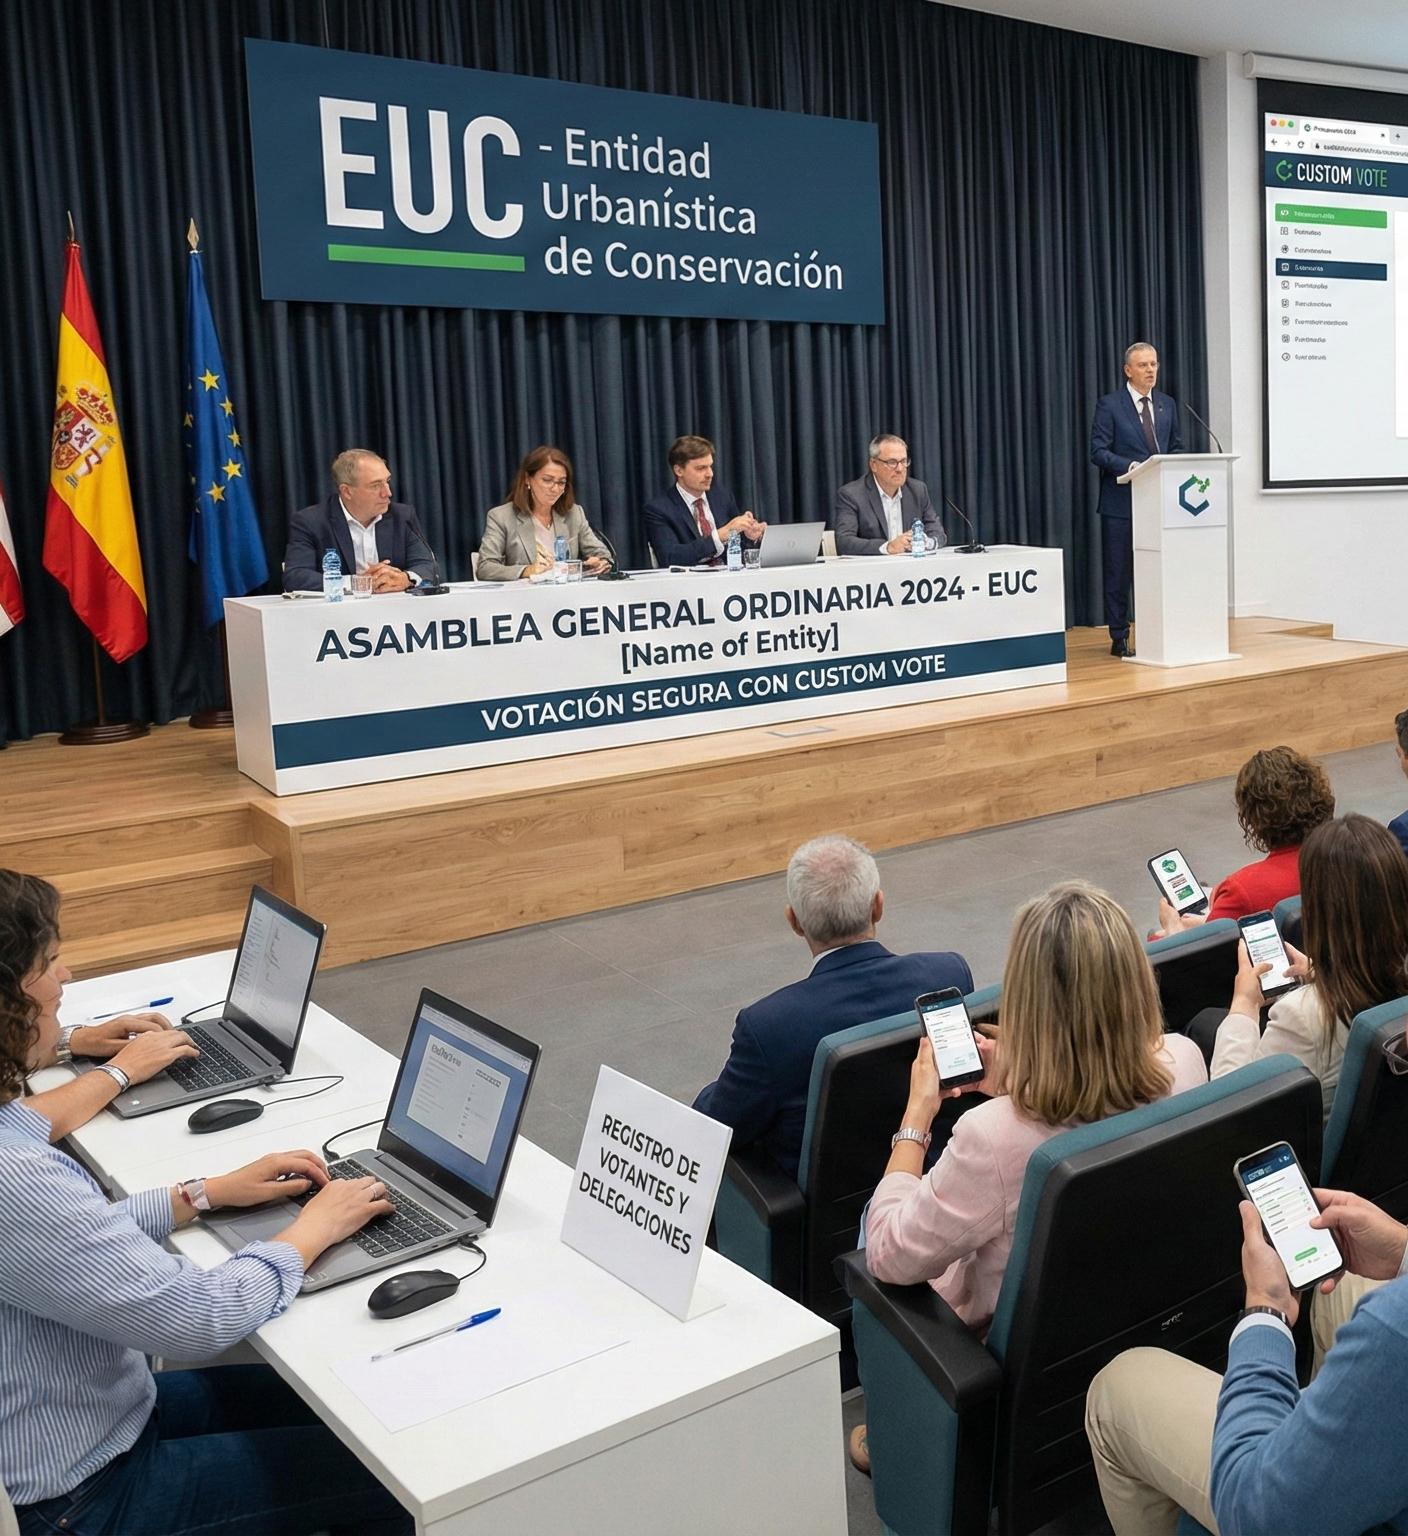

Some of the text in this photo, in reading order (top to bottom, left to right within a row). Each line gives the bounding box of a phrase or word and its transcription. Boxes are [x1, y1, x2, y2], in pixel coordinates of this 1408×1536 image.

[319, 96, 524, 239] EUC
[565, 128, 711, 180] Entidad
[1297, 163, 1387, 187] CUSTOM VOTE
[542, 181, 756, 235] Urbanística
[544, 236, 843, 290] de Conservación
[316, 612, 542, 662] ASAMBLEA
[552, 597, 715, 638] GENERAL
[723, 582, 894, 622] ORDINARIA
[900, 575, 965, 606] 2024
[988, 569, 1039, 597] EUC
[622, 622, 839, 674] [Name of Entity]
[481, 654, 946, 731] VOTACIÓN SEGURA CON CUSTOM VOTE
[600, 1146, 690, 1214] VOTANTES Y
[602, 1113, 700, 1184] REGISTRO DE
[579, 1171, 692, 1255] DELEGACIONES
